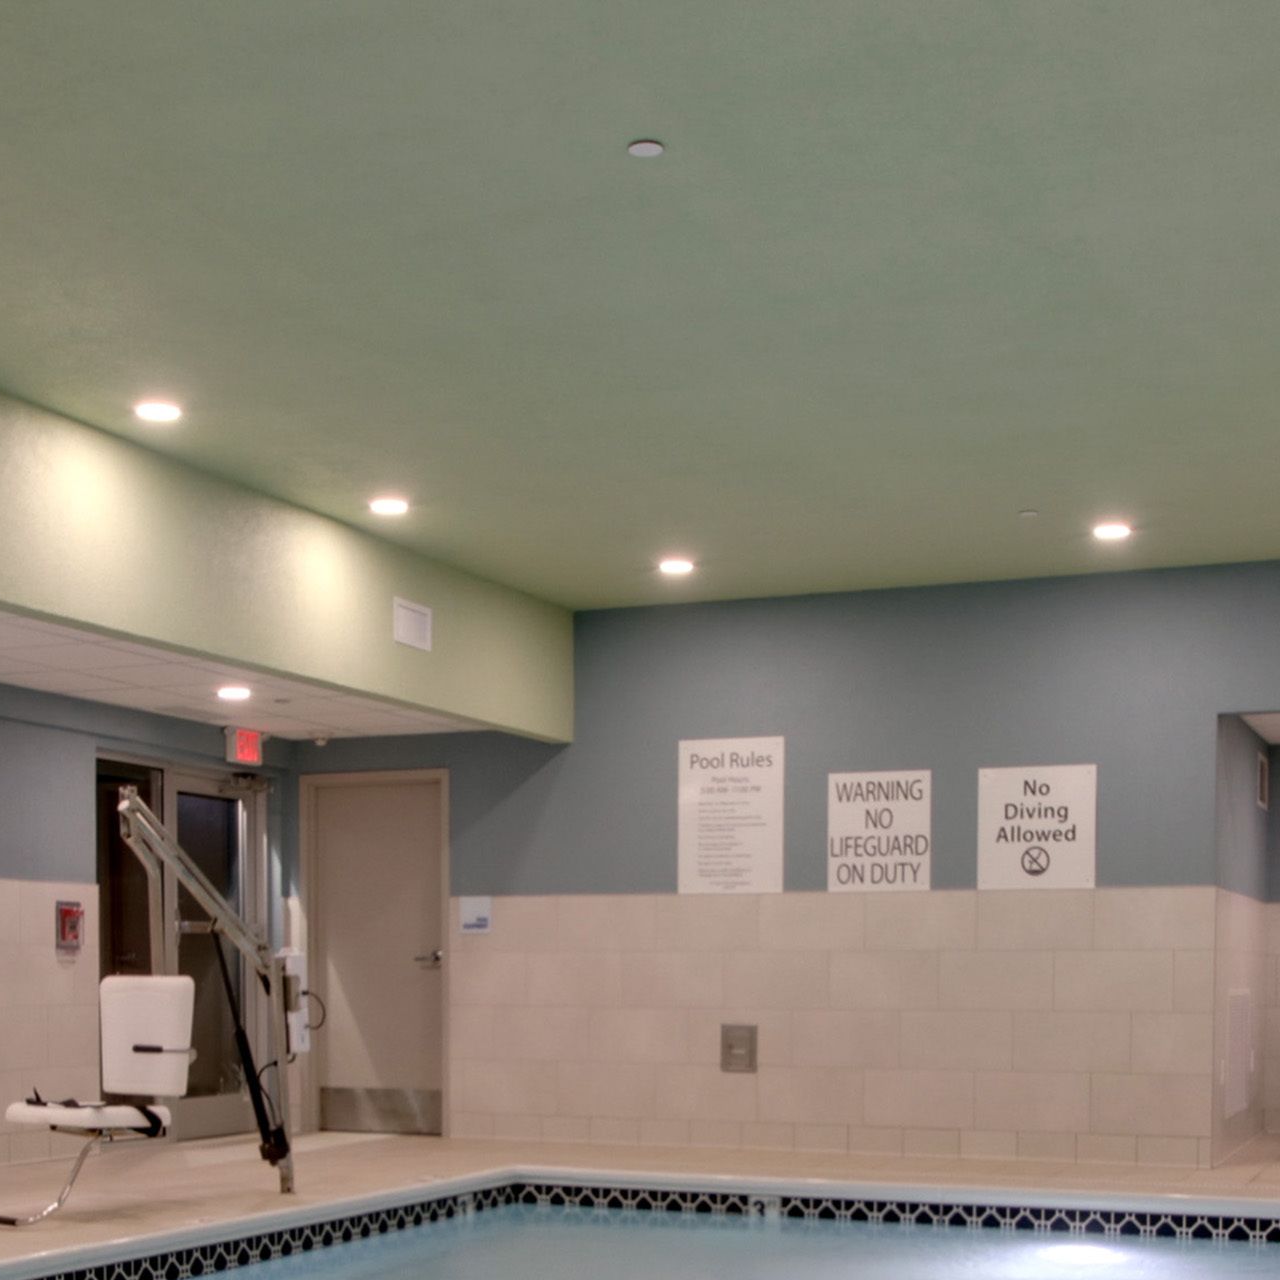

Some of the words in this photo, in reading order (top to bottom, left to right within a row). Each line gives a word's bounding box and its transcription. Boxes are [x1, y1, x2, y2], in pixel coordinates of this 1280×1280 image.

[690, 752, 725, 770] Pool
[729, 750, 774, 768] Rules
[835, 779, 924, 803] WARNING
[1023, 779, 1051, 797] No
[864, 807, 894, 829] NO
[1004, 802, 1069, 823] Diving
[995, 823, 1077, 843] Allowed
[830, 834, 929, 858] LIFEGUARD
[836, 862, 865, 885] ON
[870, 861, 922, 884] DUTY
